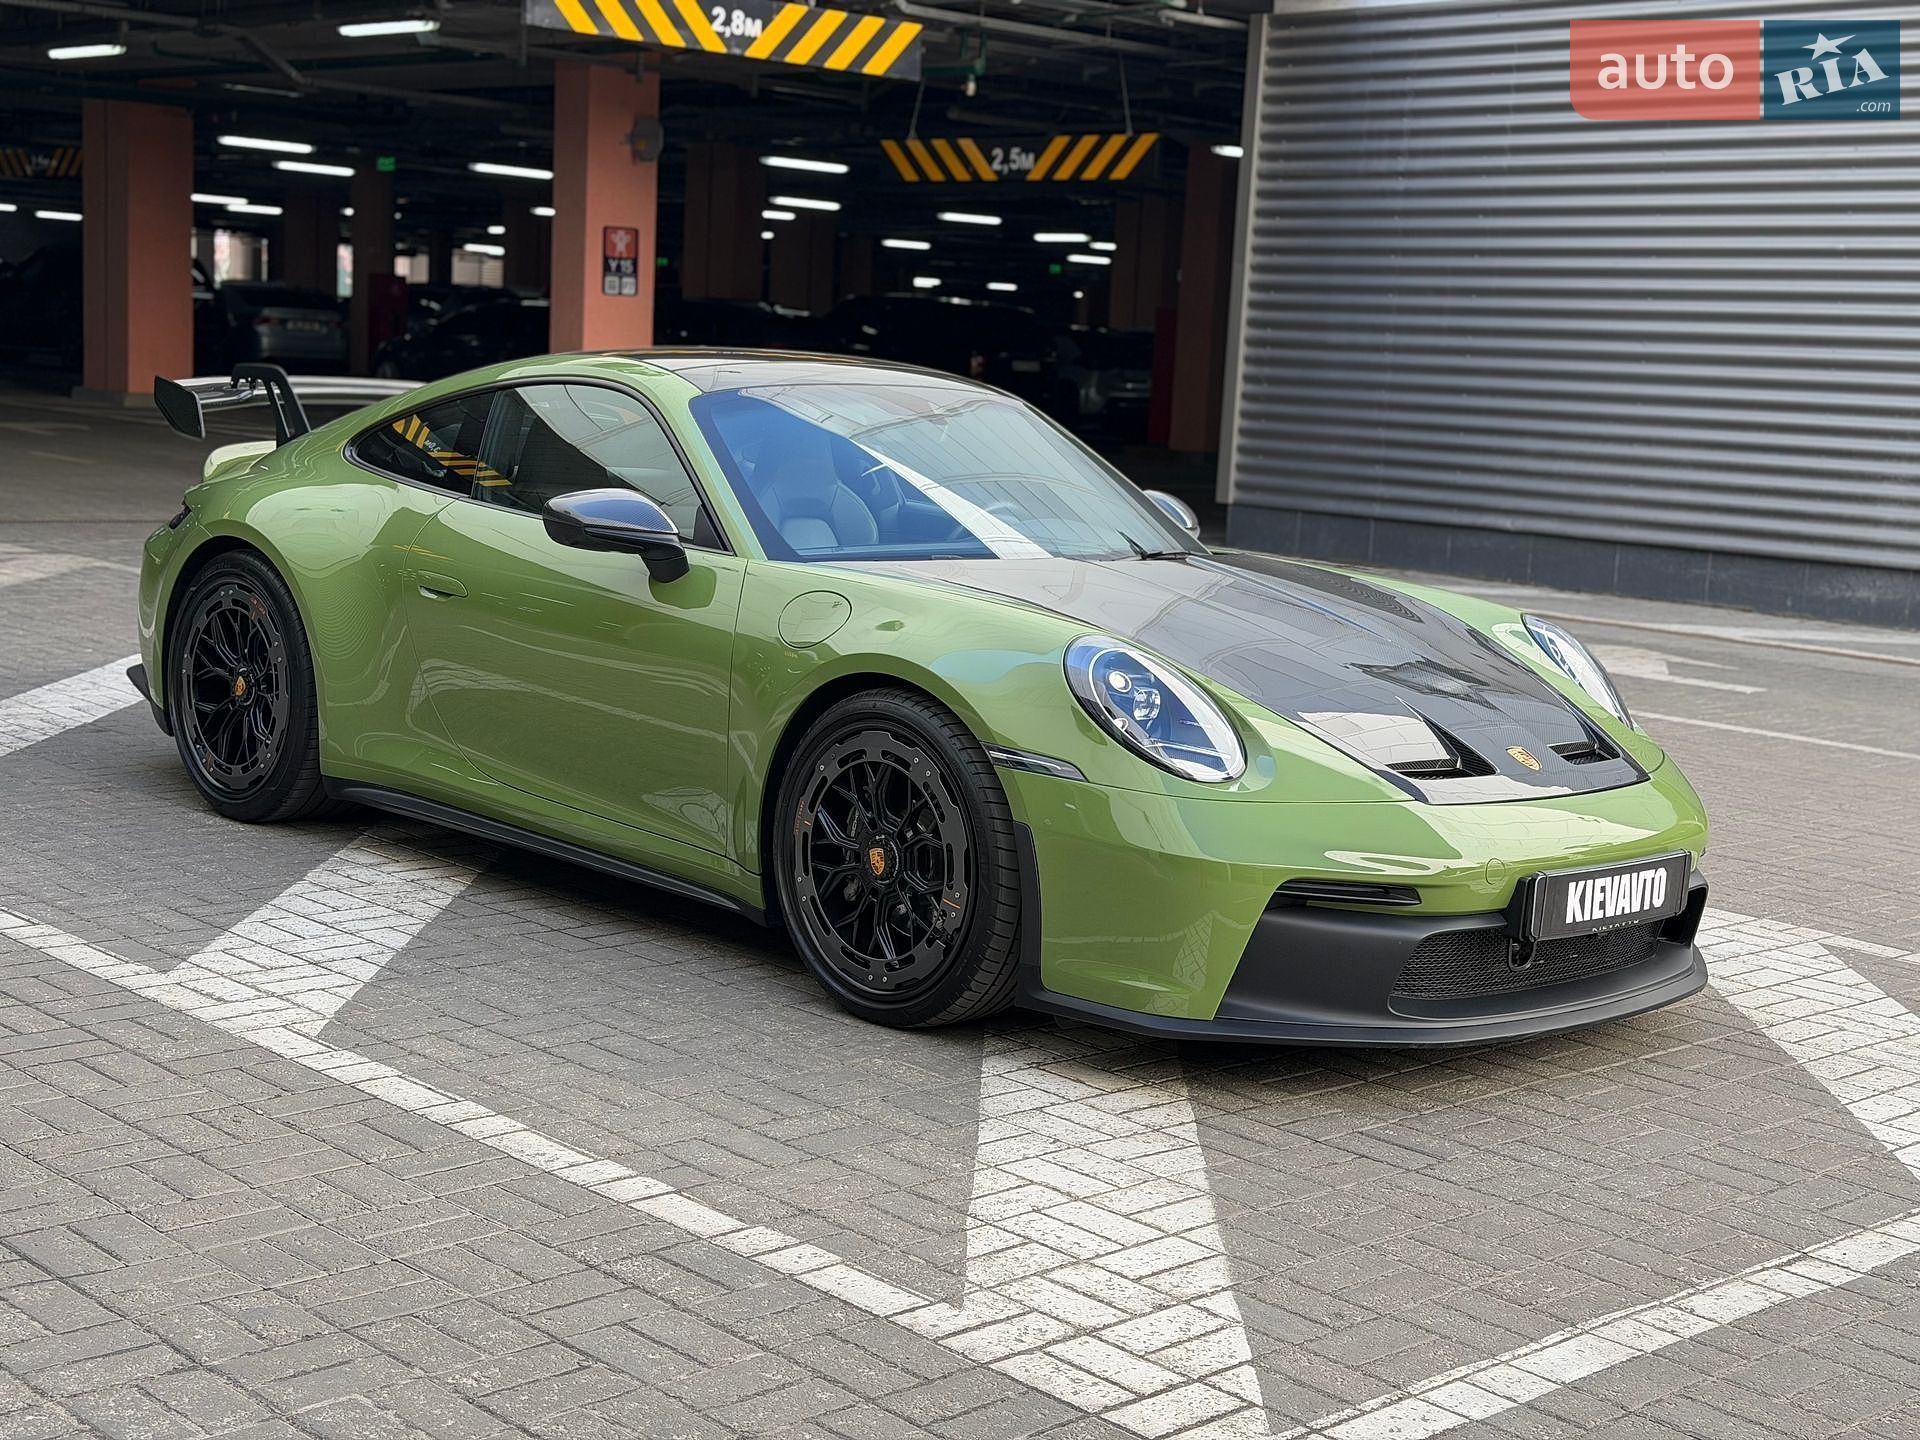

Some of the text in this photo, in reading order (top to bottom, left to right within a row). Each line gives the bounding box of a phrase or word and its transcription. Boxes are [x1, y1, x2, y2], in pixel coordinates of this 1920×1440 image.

[711, 5, 763, 38] 2,8м
[991, 147, 1035, 175] 2,5м
[1565, 867, 1667, 924] KIEVAVTO
